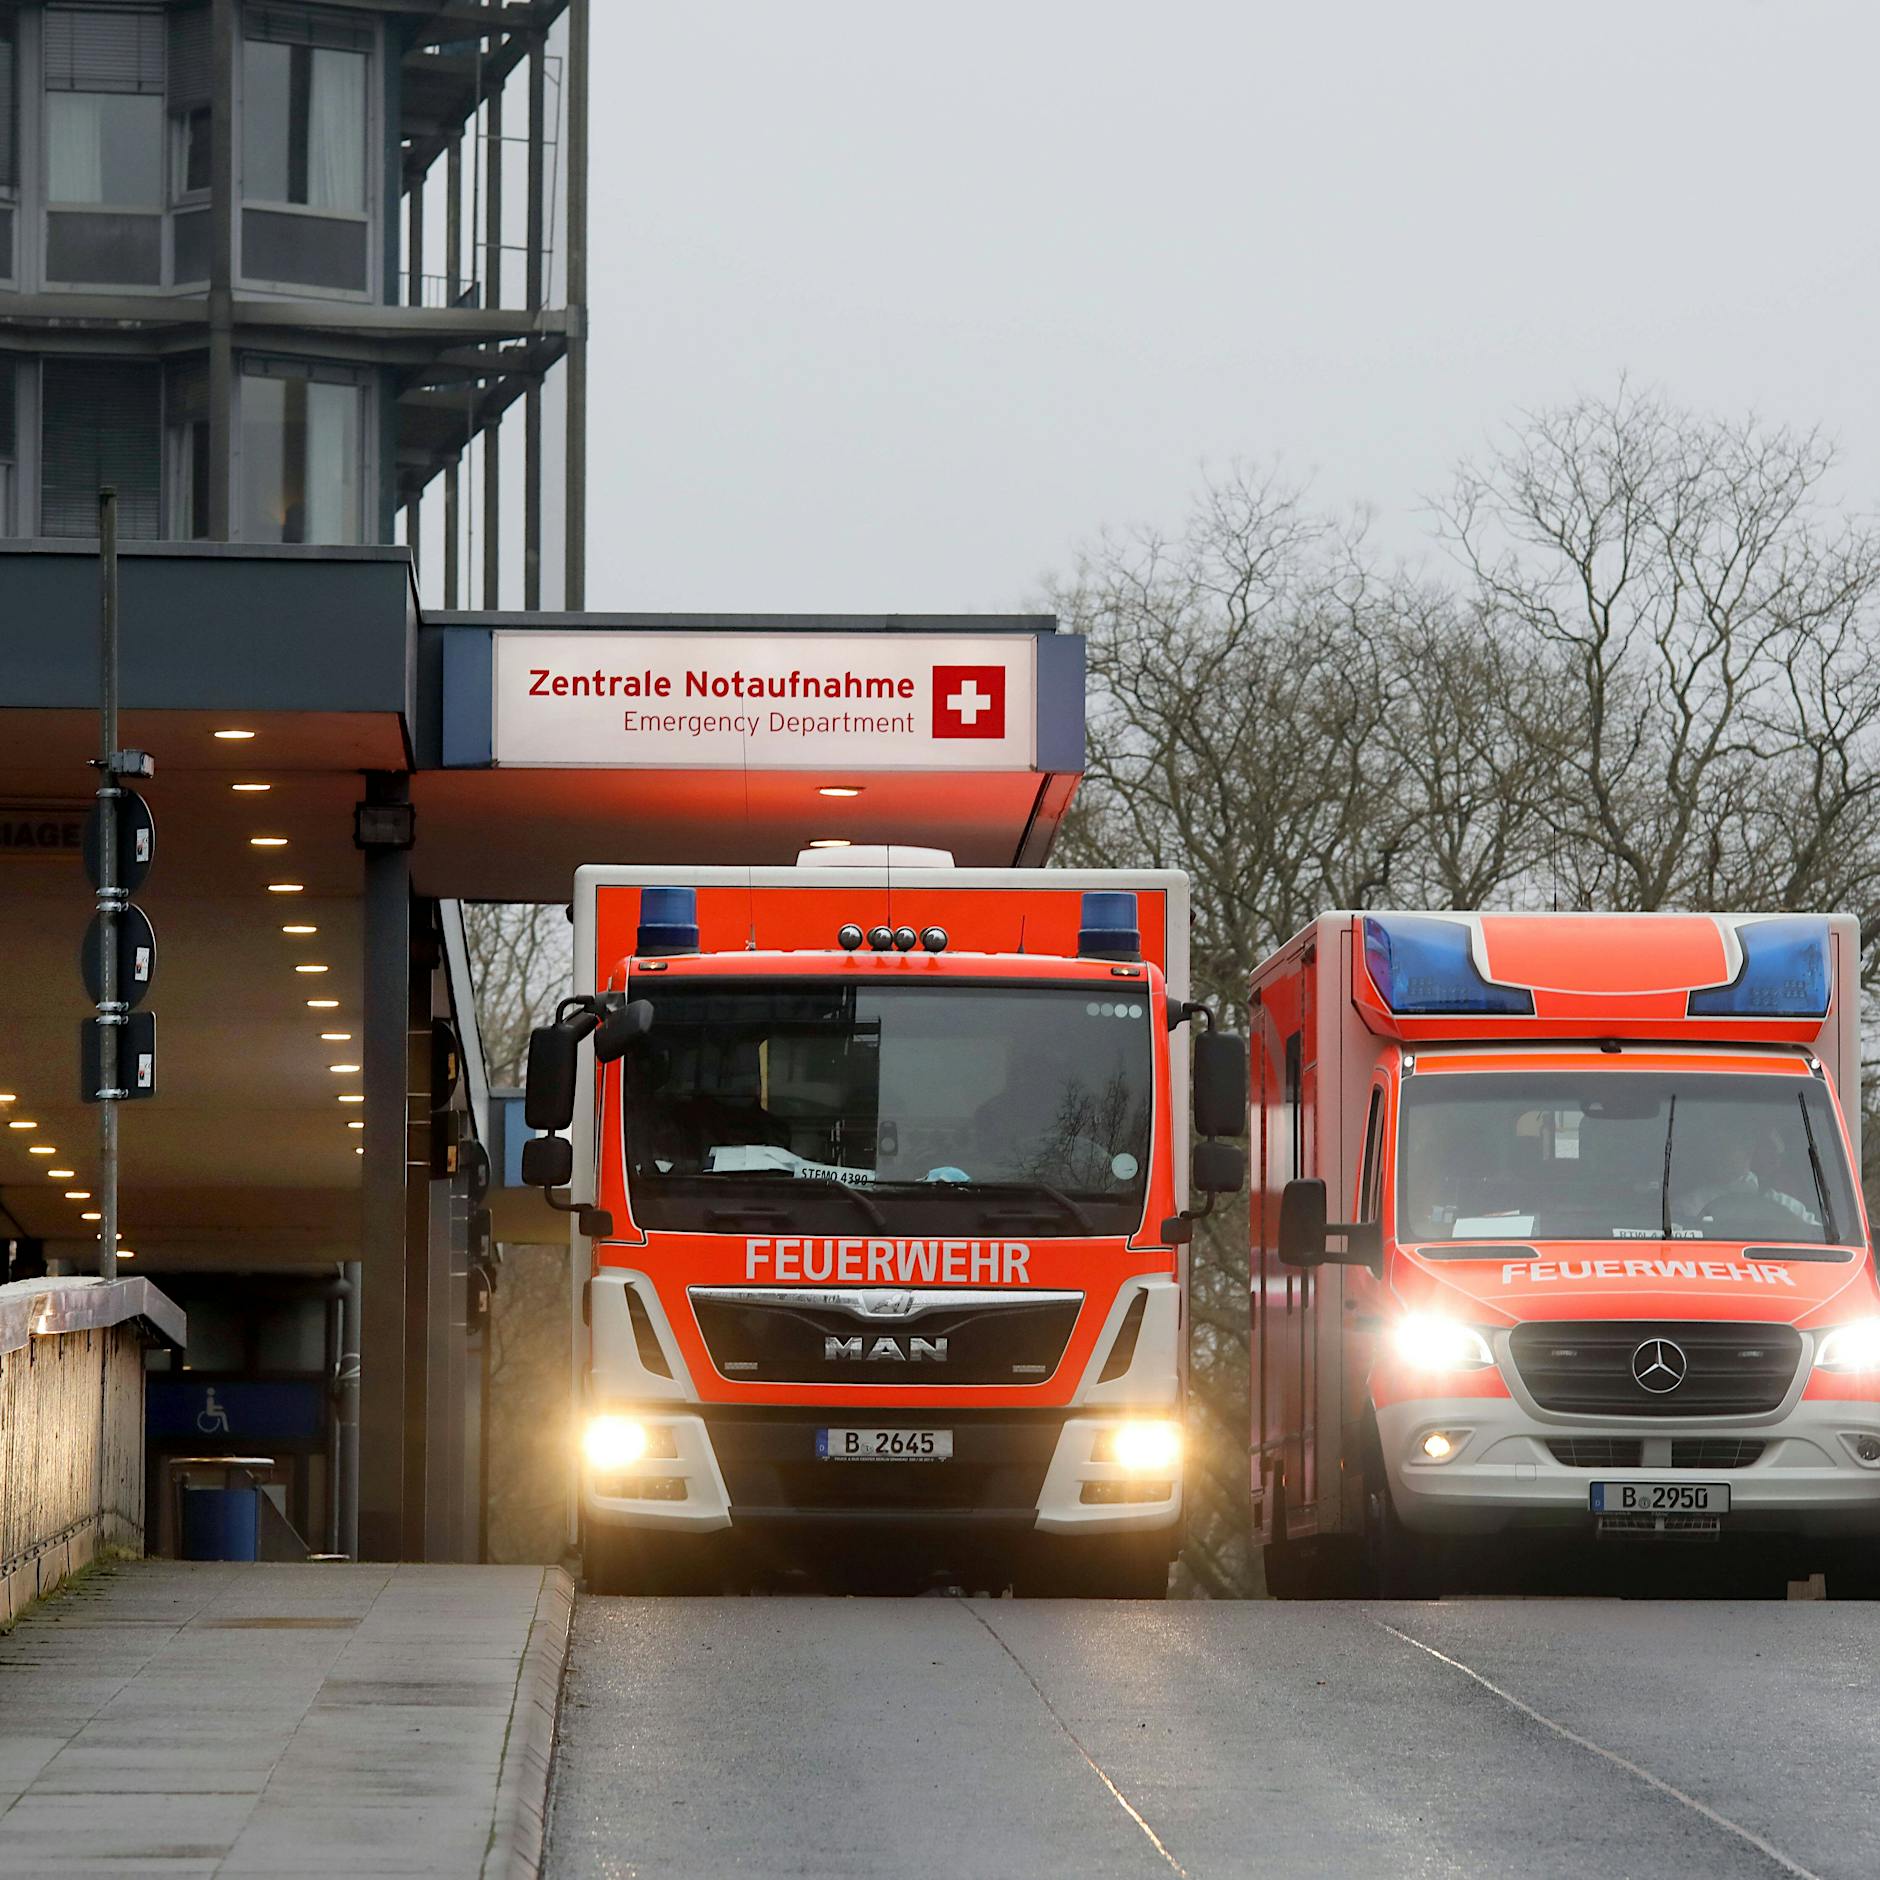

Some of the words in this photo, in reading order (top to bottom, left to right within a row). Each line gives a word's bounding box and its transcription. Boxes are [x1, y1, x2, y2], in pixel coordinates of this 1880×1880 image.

[529, 669, 671, 697] Zentrale
[685, 670, 915, 698] Notaufnahme
[624, 711, 760, 737] Emergency
[769, 711, 915, 737] Department
[745, 1238, 1031, 1284] FEUERWEHR
[1502, 1259, 1796, 1287] FEUERWEHR
[824, 1336, 948, 1361] MAN
[845, 1432, 860, 1453] B
[875, 1433, 934, 1454] 2645
[1622, 1487, 1636, 1508] B
[1652, 1487, 1708, 1509] 2950
